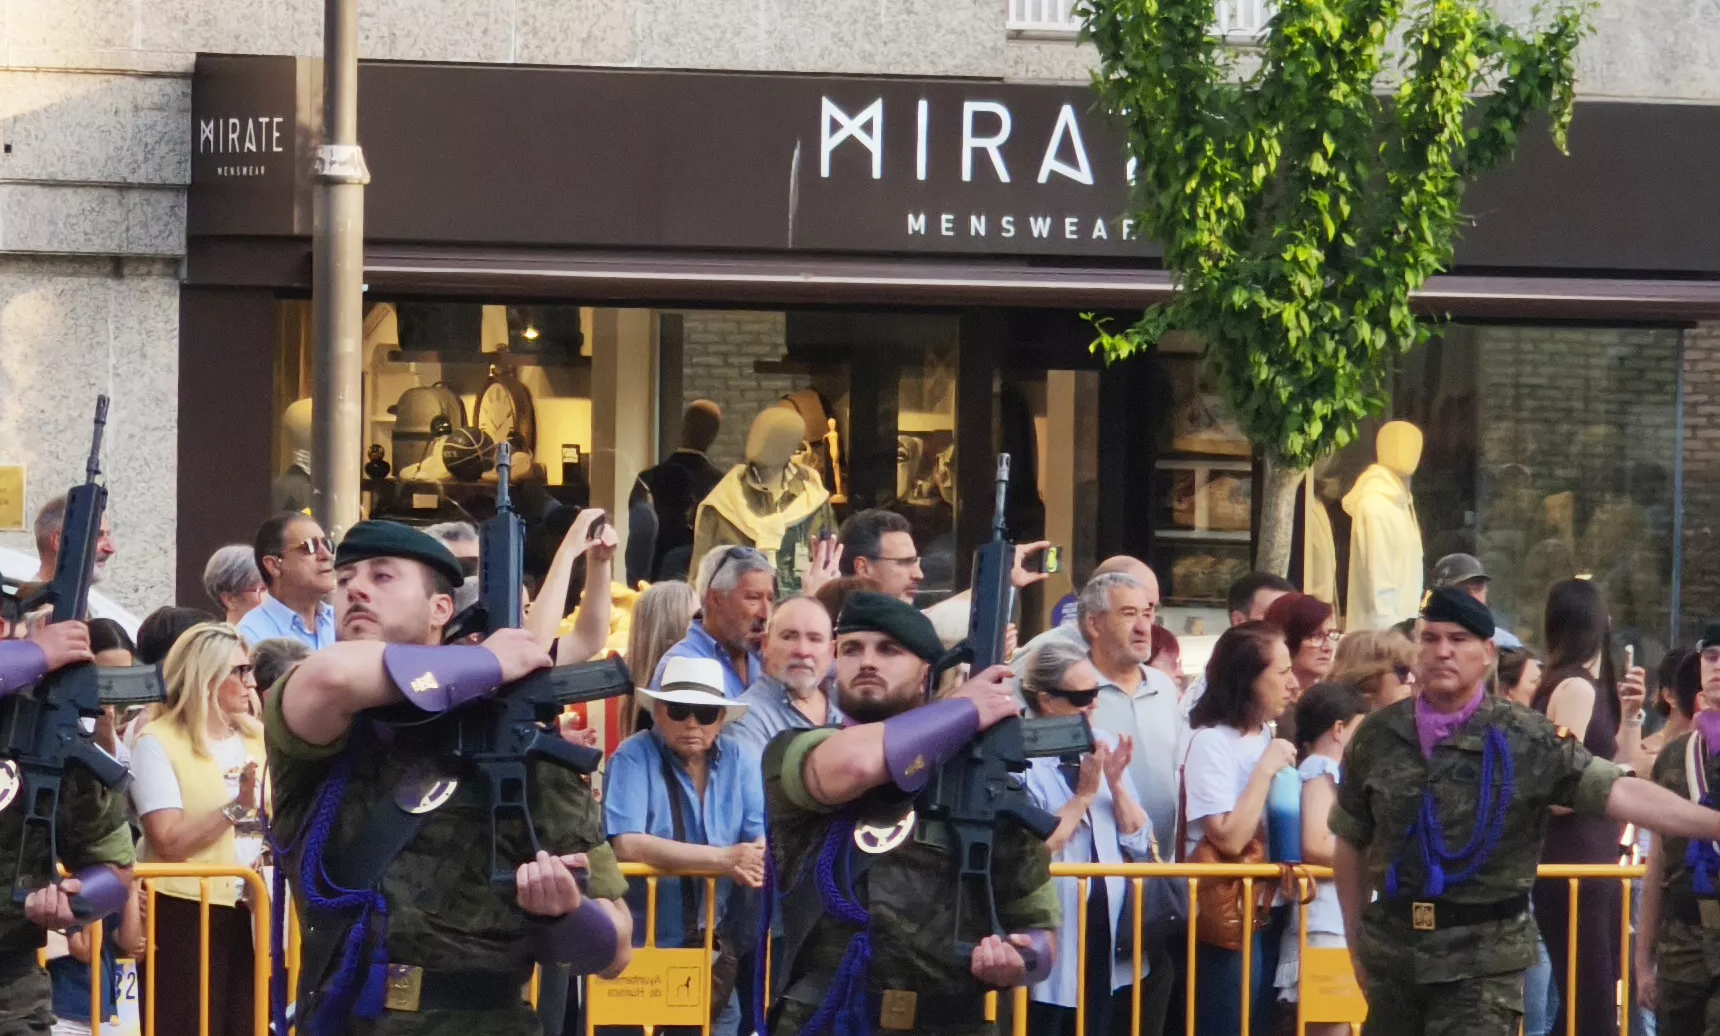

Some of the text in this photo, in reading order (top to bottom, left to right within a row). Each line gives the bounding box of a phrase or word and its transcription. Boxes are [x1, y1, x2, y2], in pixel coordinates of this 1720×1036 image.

[200, 117, 284, 154] MIRATE
[820, 95, 1140, 186] MIRA
[217, 165, 266, 177] MENSWEAR
